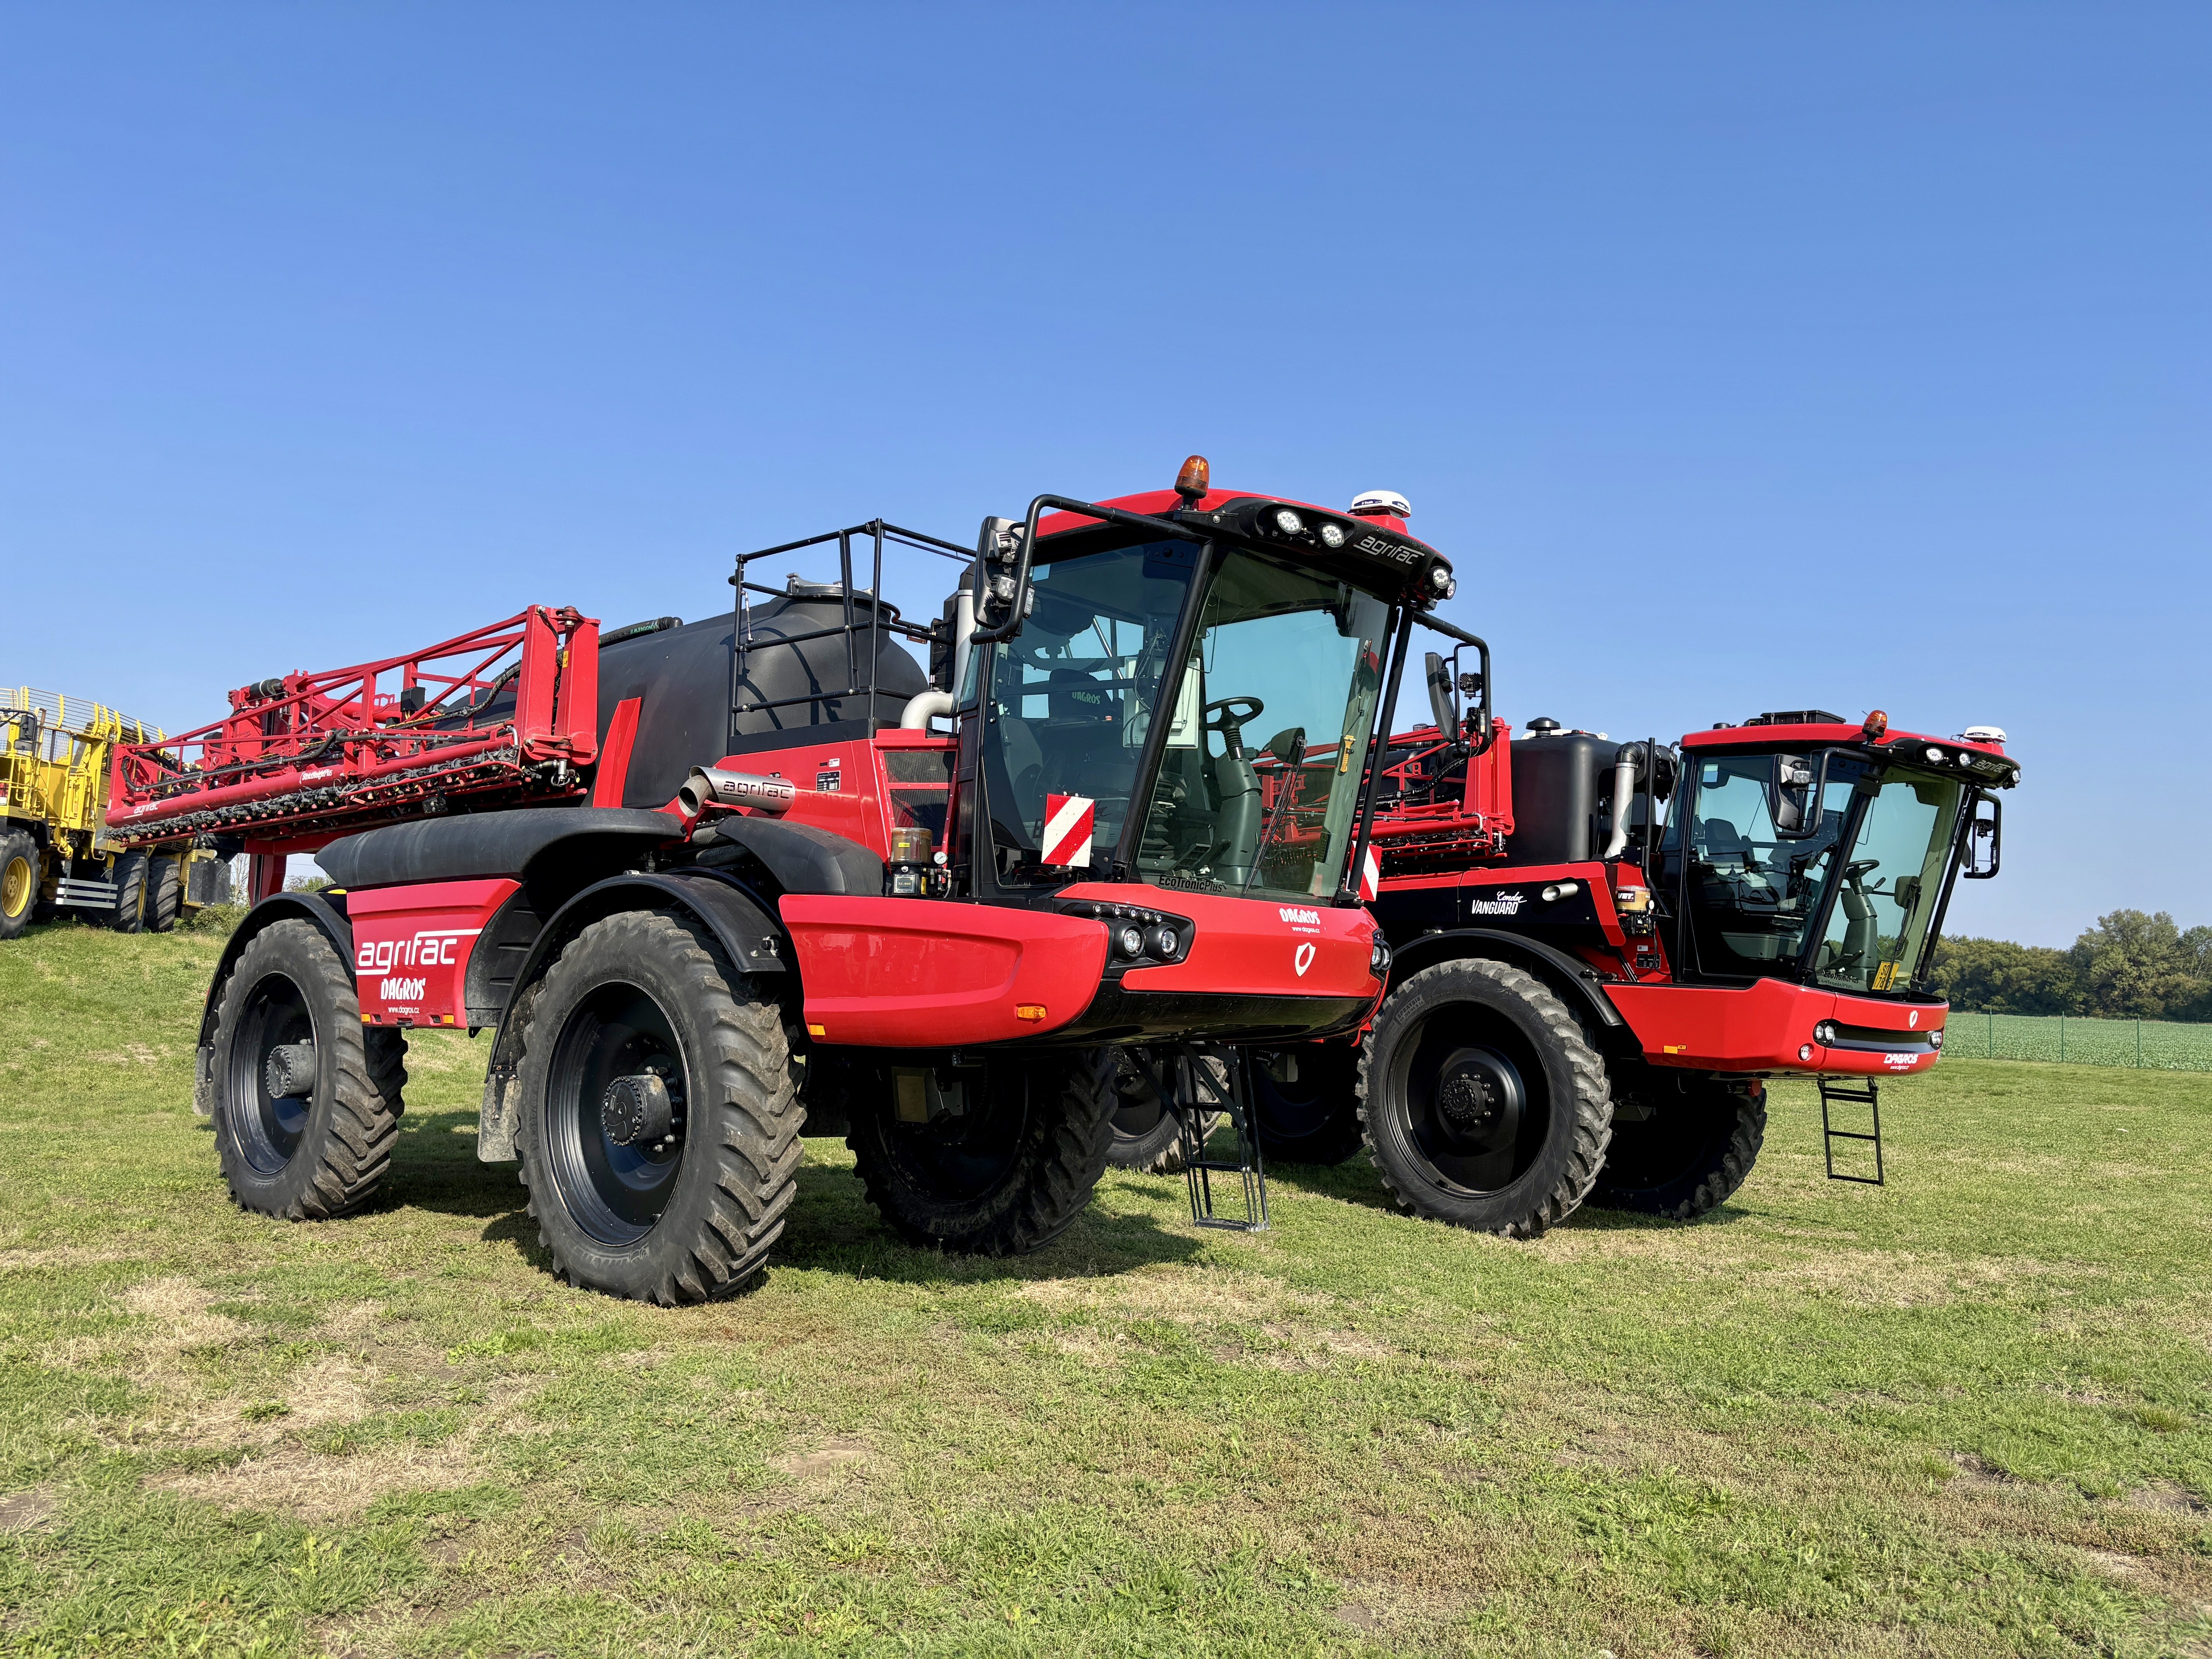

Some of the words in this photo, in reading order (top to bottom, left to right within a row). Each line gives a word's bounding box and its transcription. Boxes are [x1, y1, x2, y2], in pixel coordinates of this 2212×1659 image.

[1353, 536, 1425, 565] agrifac
[1072, 692, 1101, 704] DAGROS
[1971, 759, 2011, 773] agrifac
[718, 781, 793, 799] agrifac
[1159, 874, 1223, 892] EcoTronicPlus
[1497, 891, 1527, 903] Condor
[1472, 900, 1518, 915] VANGUARD
[1279, 908, 1321, 925] DAGROS
[356, 928, 483, 975] agrifac
[381, 977, 426, 1000] DAGROS
[388, 1006, 420, 1015] www.dagros.cz
[1883, 1054, 1918, 1064] DAGROS
